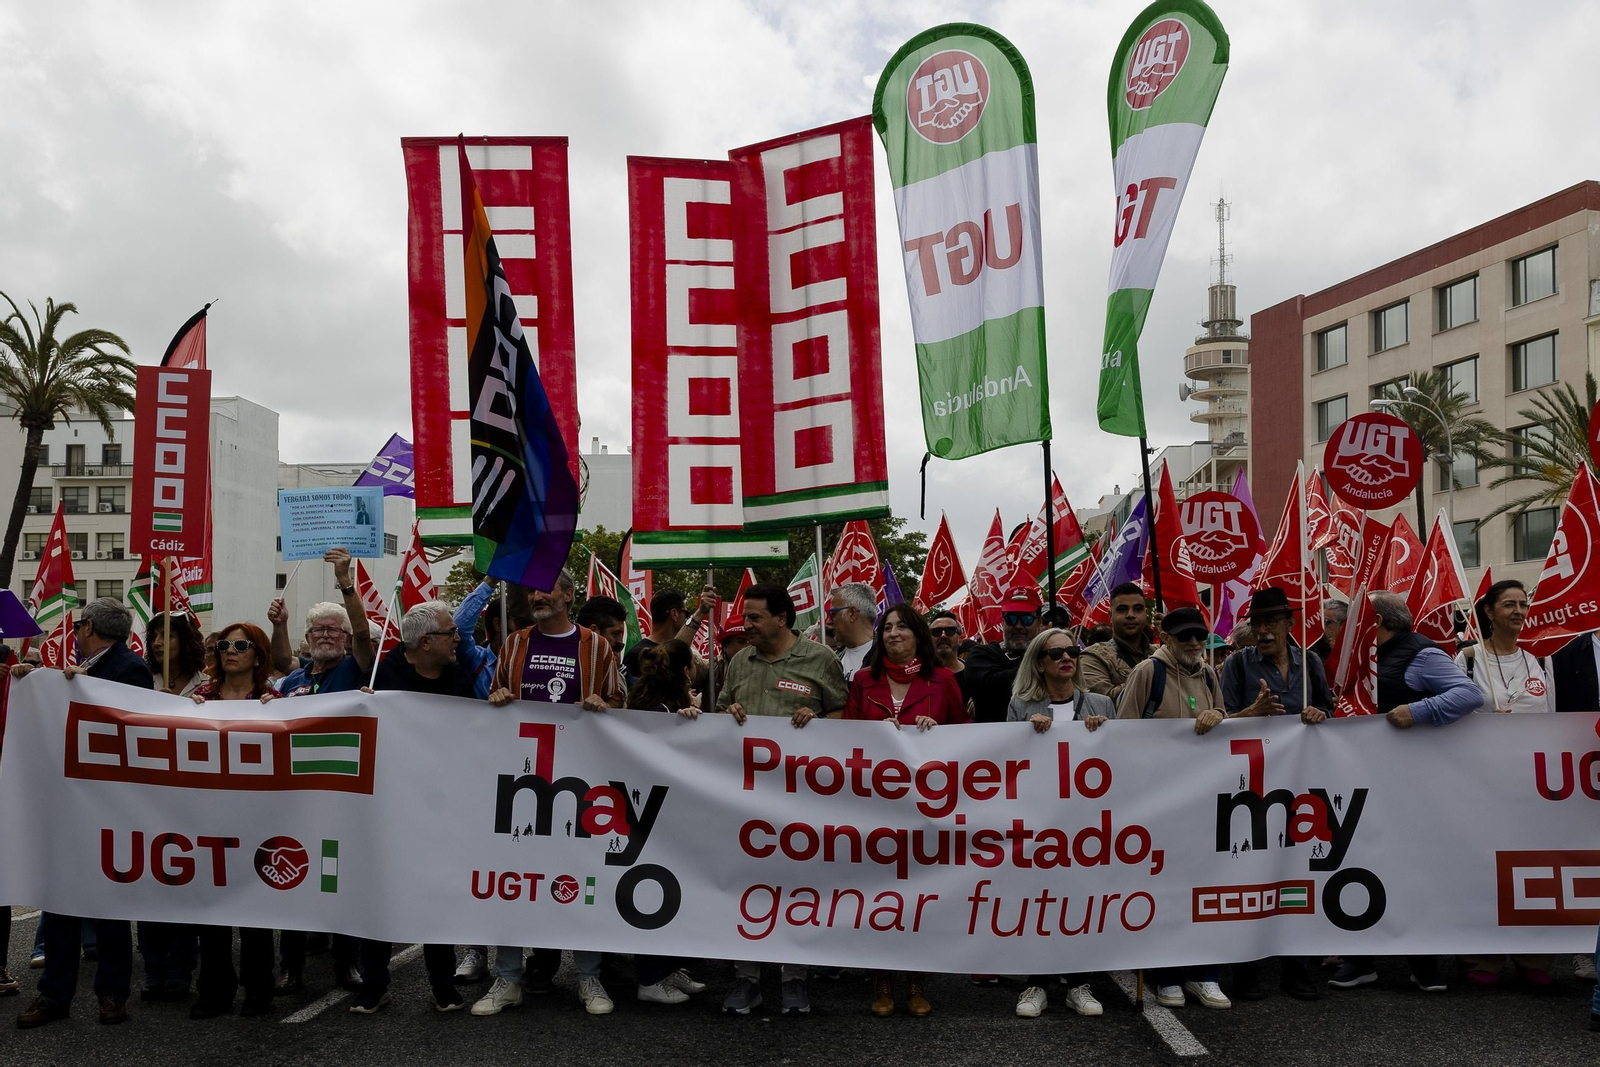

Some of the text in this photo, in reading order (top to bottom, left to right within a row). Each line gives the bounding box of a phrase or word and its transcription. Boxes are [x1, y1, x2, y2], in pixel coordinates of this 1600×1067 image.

[1132, 31, 1182, 77] UGT
[1115, 177, 1177, 248] GT
[761, 134, 855, 493] CCOO
[663, 177, 741, 526] CCOO
[153, 372, 189, 509] CCOO
[1339, 421, 1409, 462] UGT
[332, 493, 352, 501] TODOS
[1341, 483, 1393, 500] Andalucía
[1180, 501, 1242, 535] UGT
[150, 538, 185, 552] Cádiz
[1539, 520, 1575, 582] GT
[1190, 561, 1238, 574] Andalucía
[529, 663, 575, 673] enseñanza
[530, 655, 566, 665] CCOO
[555, 671, 574, 679] Cádiz
[778, 680, 806, 693] CCOO
[78, 720, 274, 776] CCOO
[742, 737, 1113, 818] Proteger lo
[101, 828, 240, 887] UGT
[739, 809, 1165, 880] conquistado,
[471, 870, 545, 902] UGT
[1198, 888, 1277, 916] CCOO
[737, 879, 1156, 941] ganar futuro
